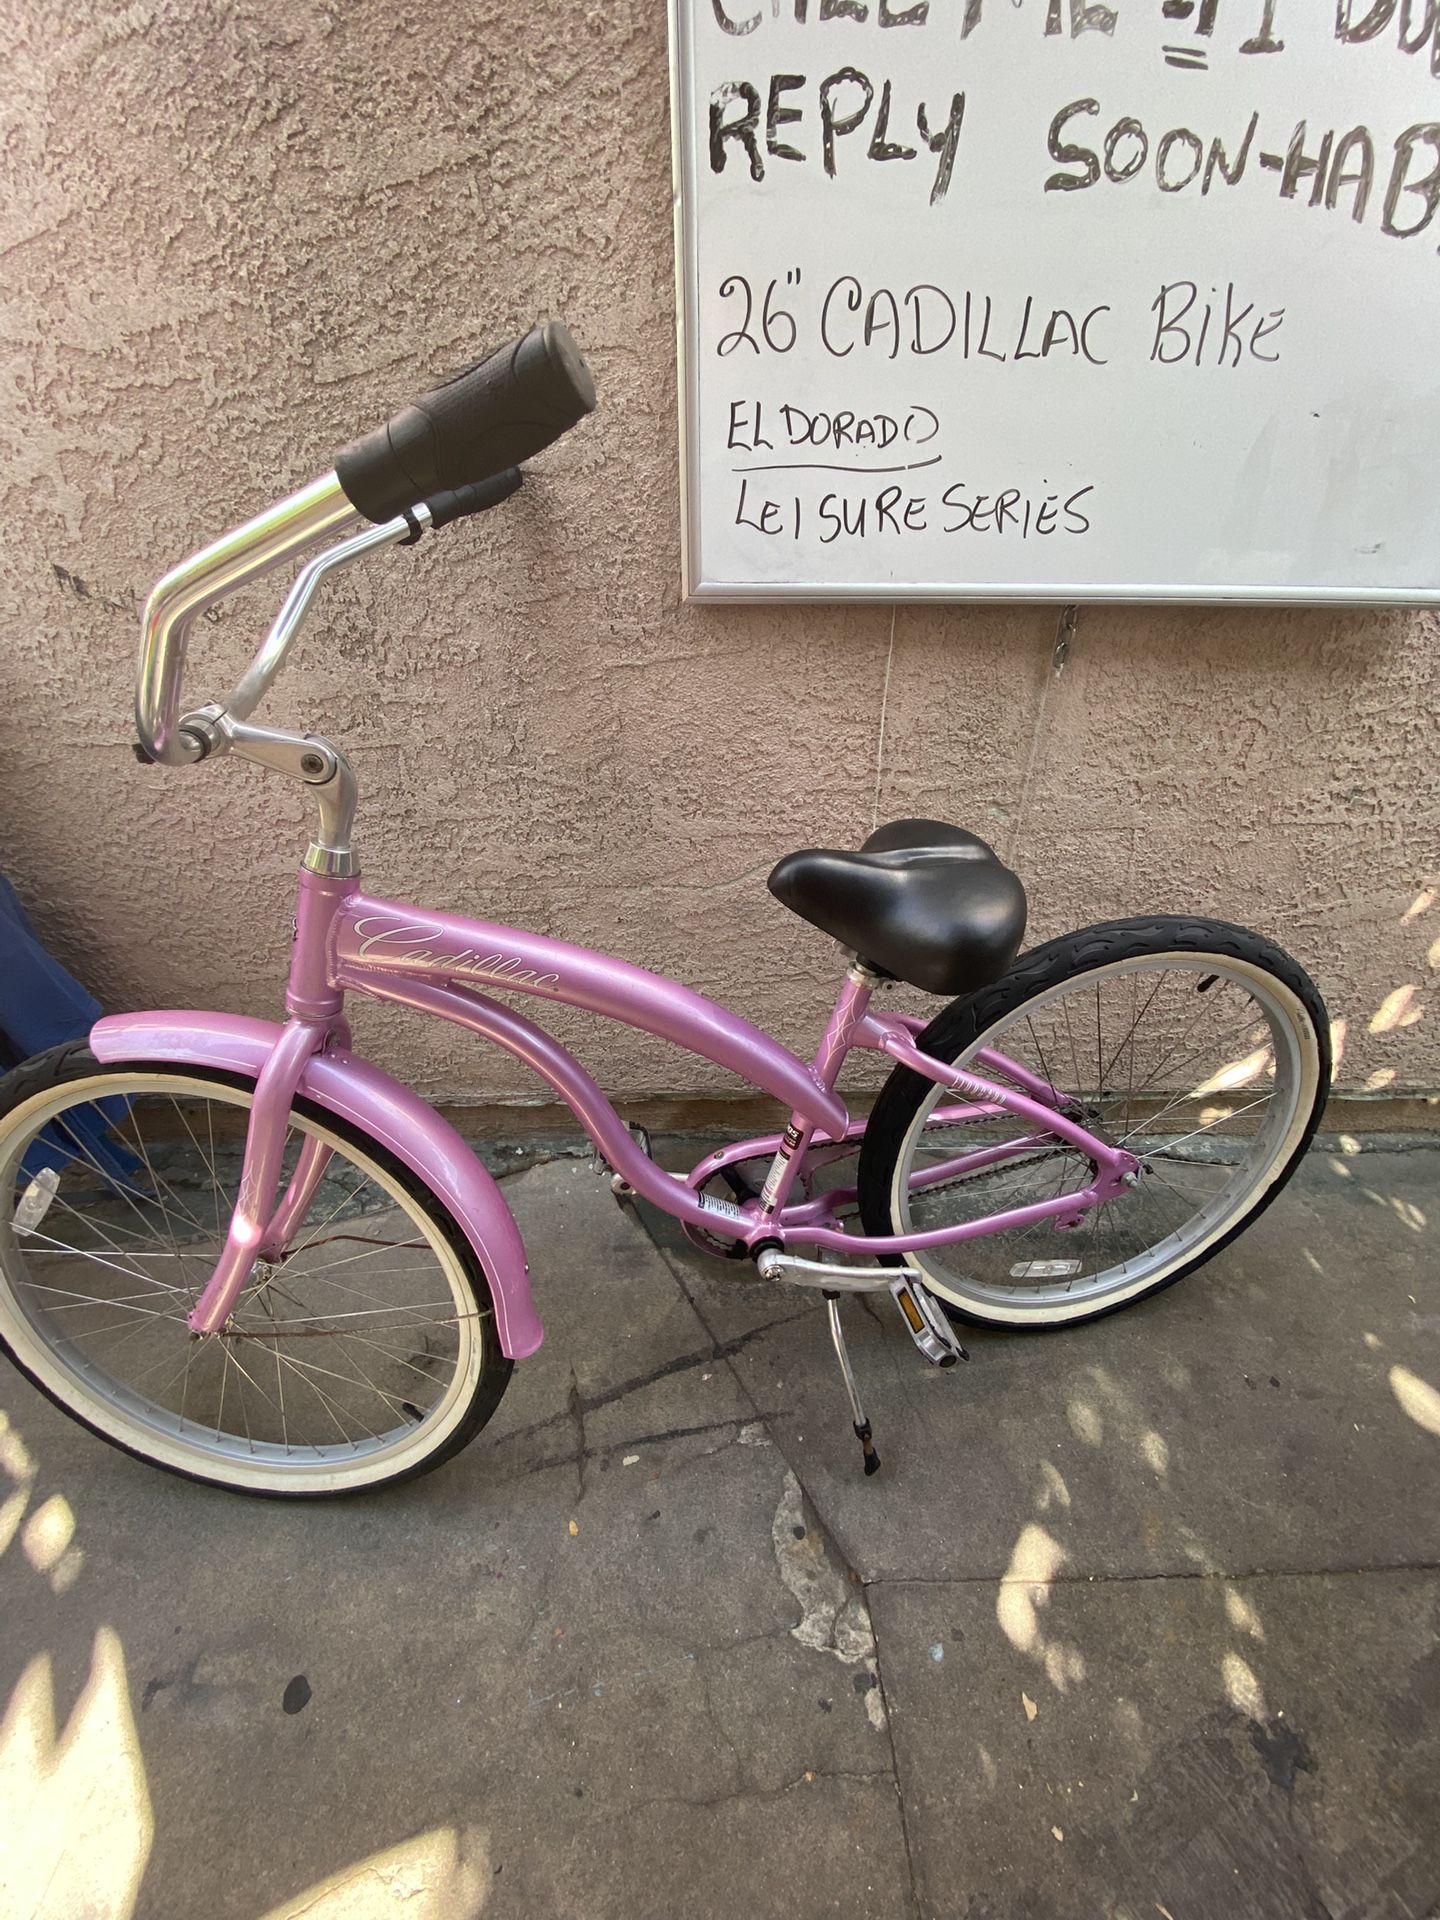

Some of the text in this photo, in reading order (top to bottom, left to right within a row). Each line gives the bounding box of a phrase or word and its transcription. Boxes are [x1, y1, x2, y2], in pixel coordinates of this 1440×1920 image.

[716, 267, 801, 357] 26"
[820, 275, 1111, 366] CADILLAC
[735, 479, 927, 543] LEISURE
[353, 916, 560, 989] Cadillac
